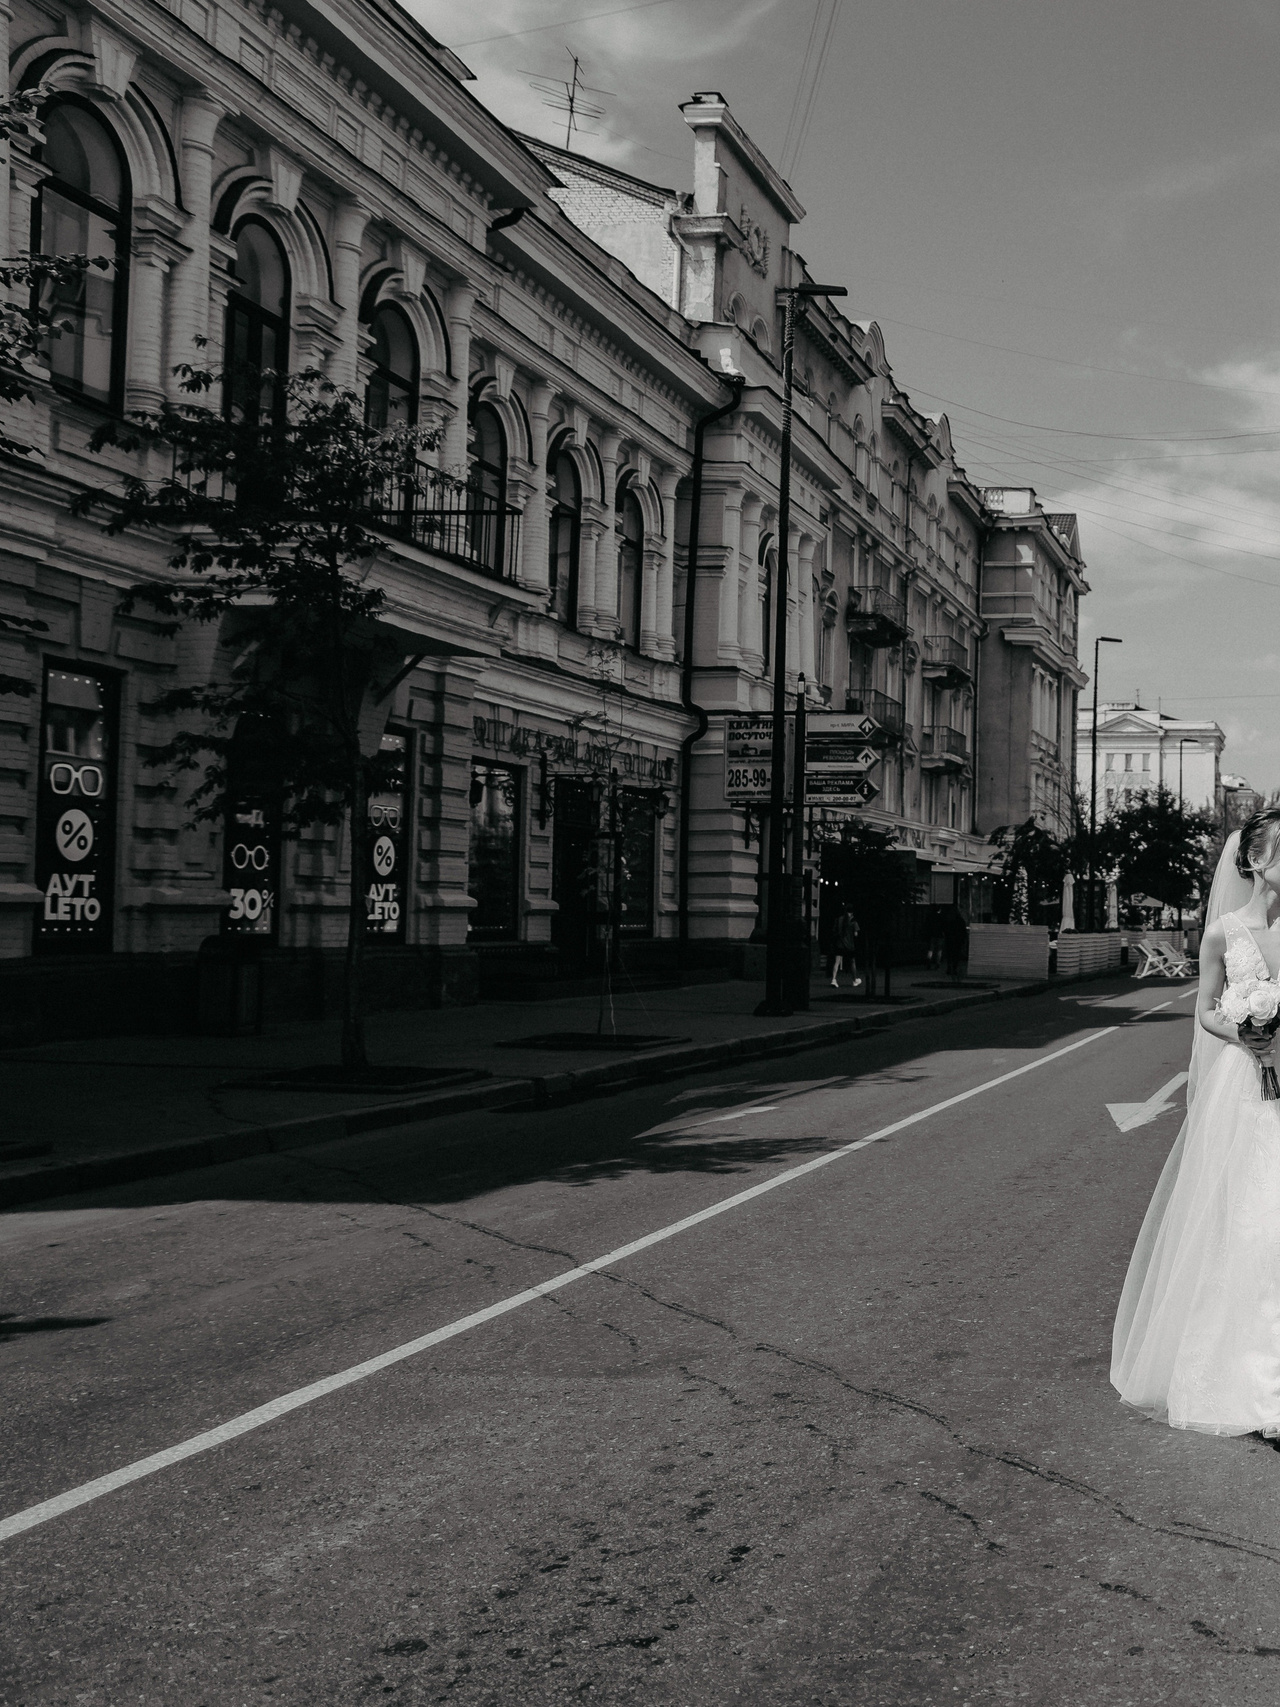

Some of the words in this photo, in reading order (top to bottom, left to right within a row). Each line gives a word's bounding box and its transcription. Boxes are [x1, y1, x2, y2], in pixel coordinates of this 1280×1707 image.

[728, 720, 773, 730] КВАРТИ
[728, 732, 773, 741] ПОСУТОЧ
[727, 769, 771, 788] 285-99-
[43, 896, 101, 922] LETO
[228, 887, 274, 921] 30%
